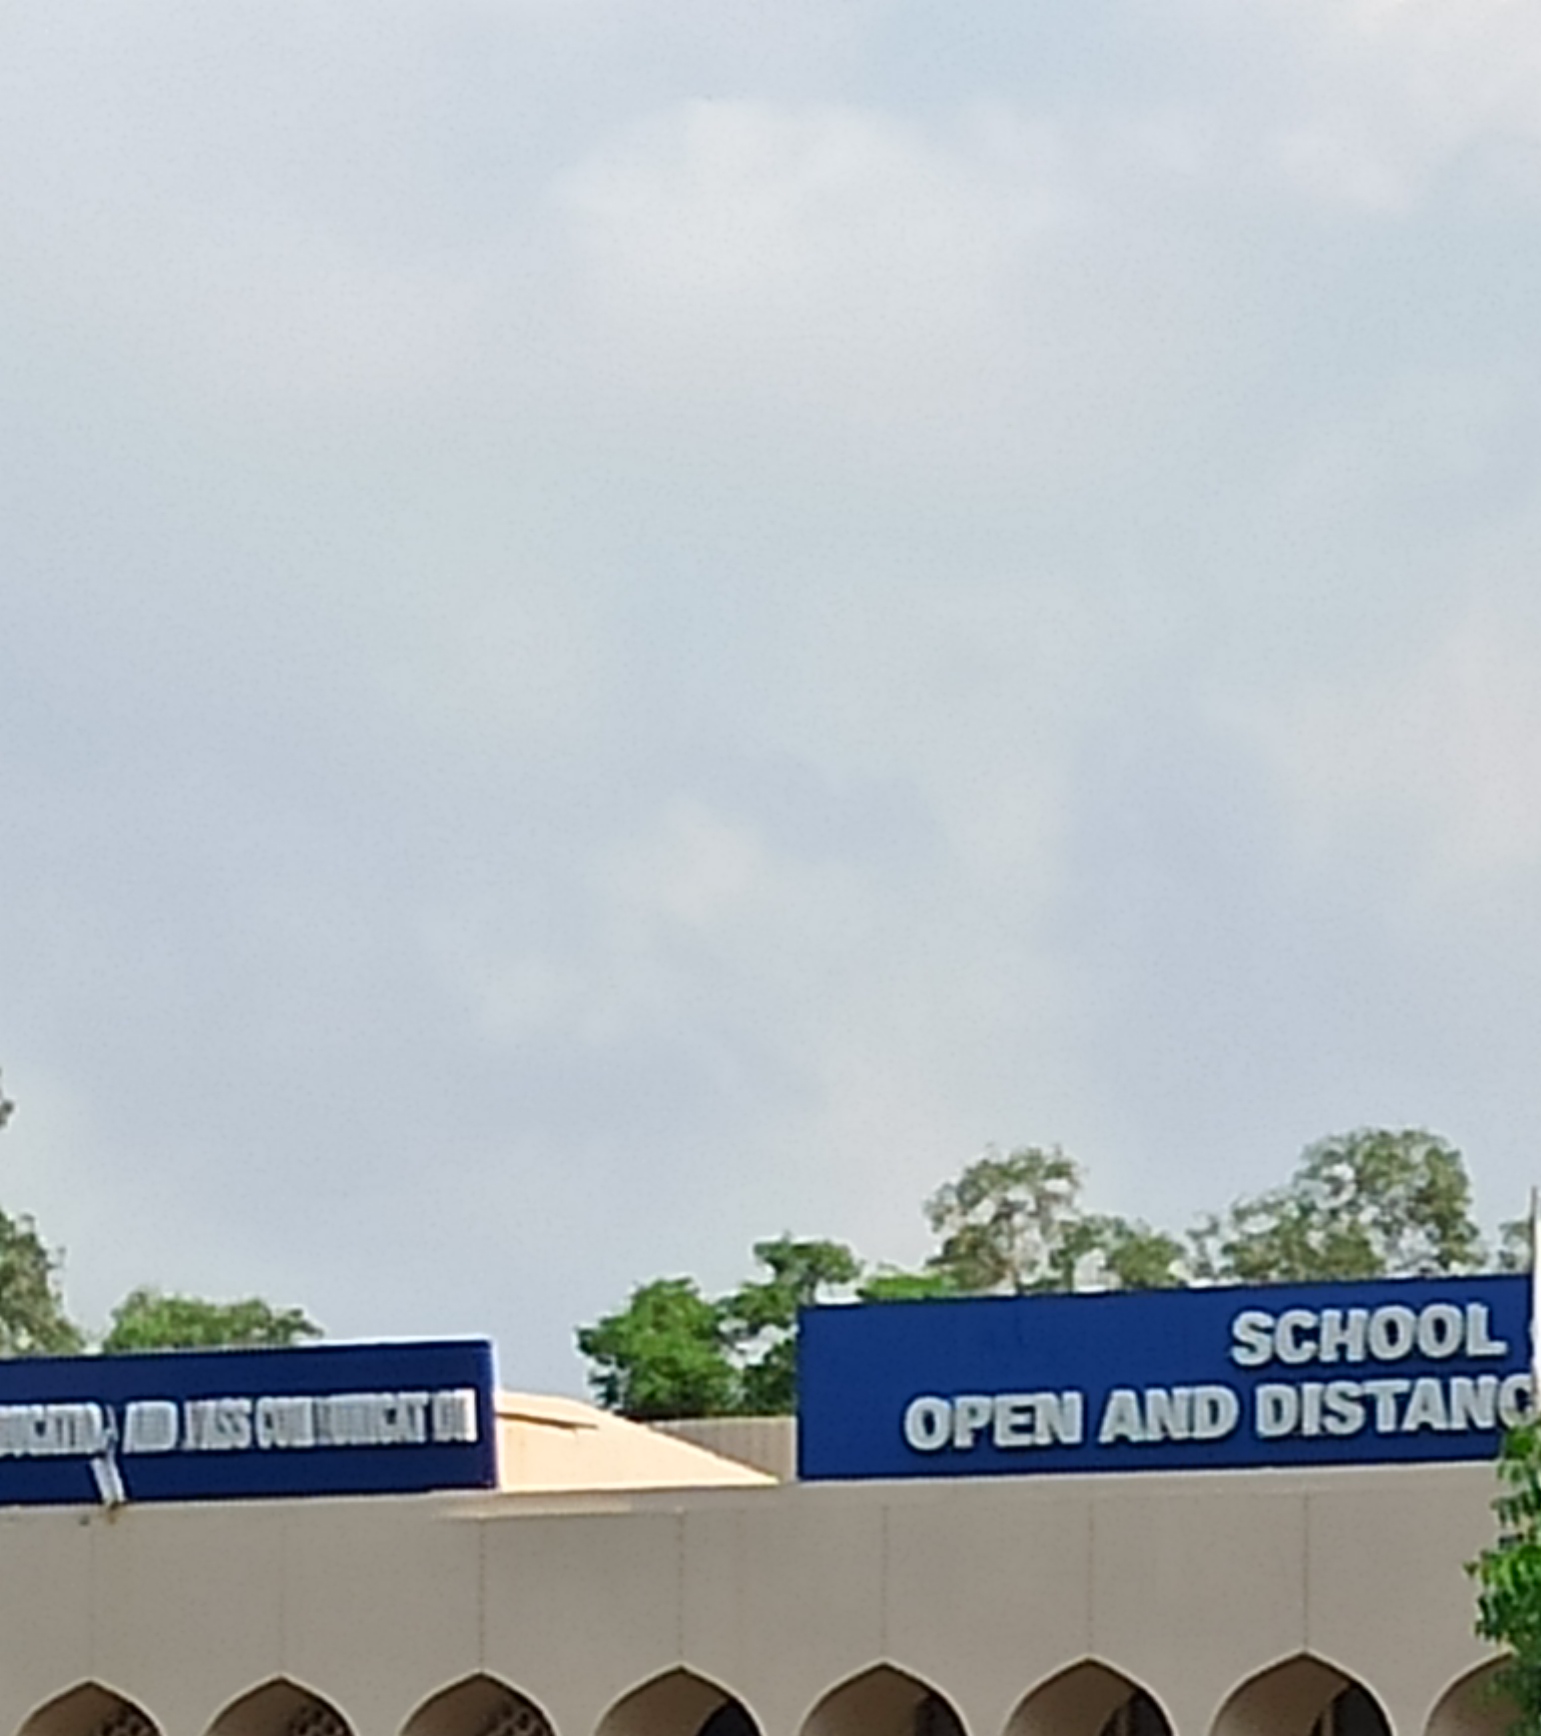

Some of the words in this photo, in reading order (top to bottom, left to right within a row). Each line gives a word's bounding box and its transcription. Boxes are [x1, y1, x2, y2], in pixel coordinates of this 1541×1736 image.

[1231, 1303, 1507, 1366] SCHOOL
[904, 1391, 1083, 1450] OPEN
[1099, 1384, 1239, 1442] AND
